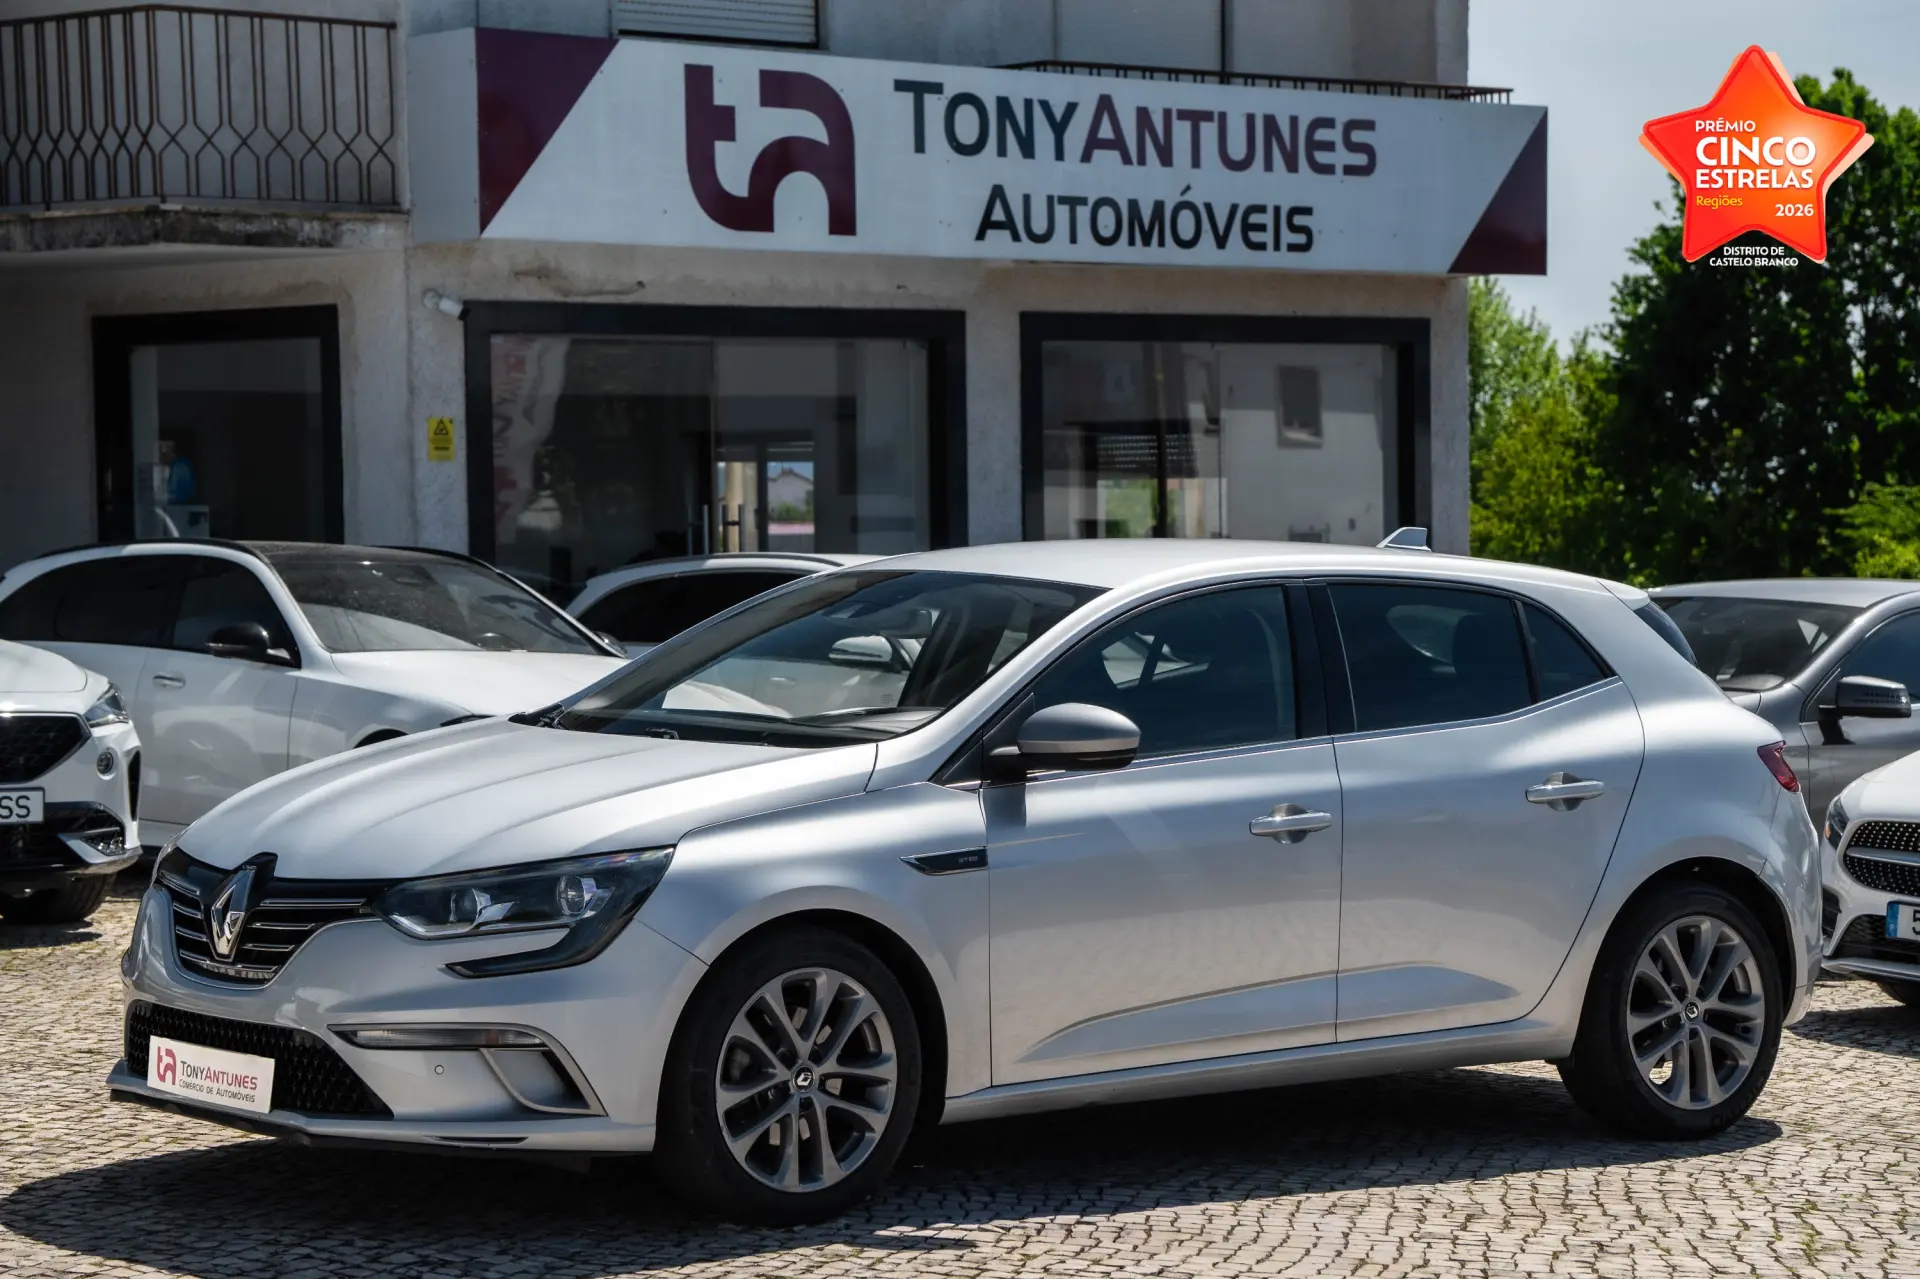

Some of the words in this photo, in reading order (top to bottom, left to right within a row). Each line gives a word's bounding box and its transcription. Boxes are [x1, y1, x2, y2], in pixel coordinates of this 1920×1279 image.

[894, 78, 1377, 177] TONYANTUNES
[974, 183, 1314, 253] AUTOMÓVEIS
[206, 1085, 214, 1095] DE
